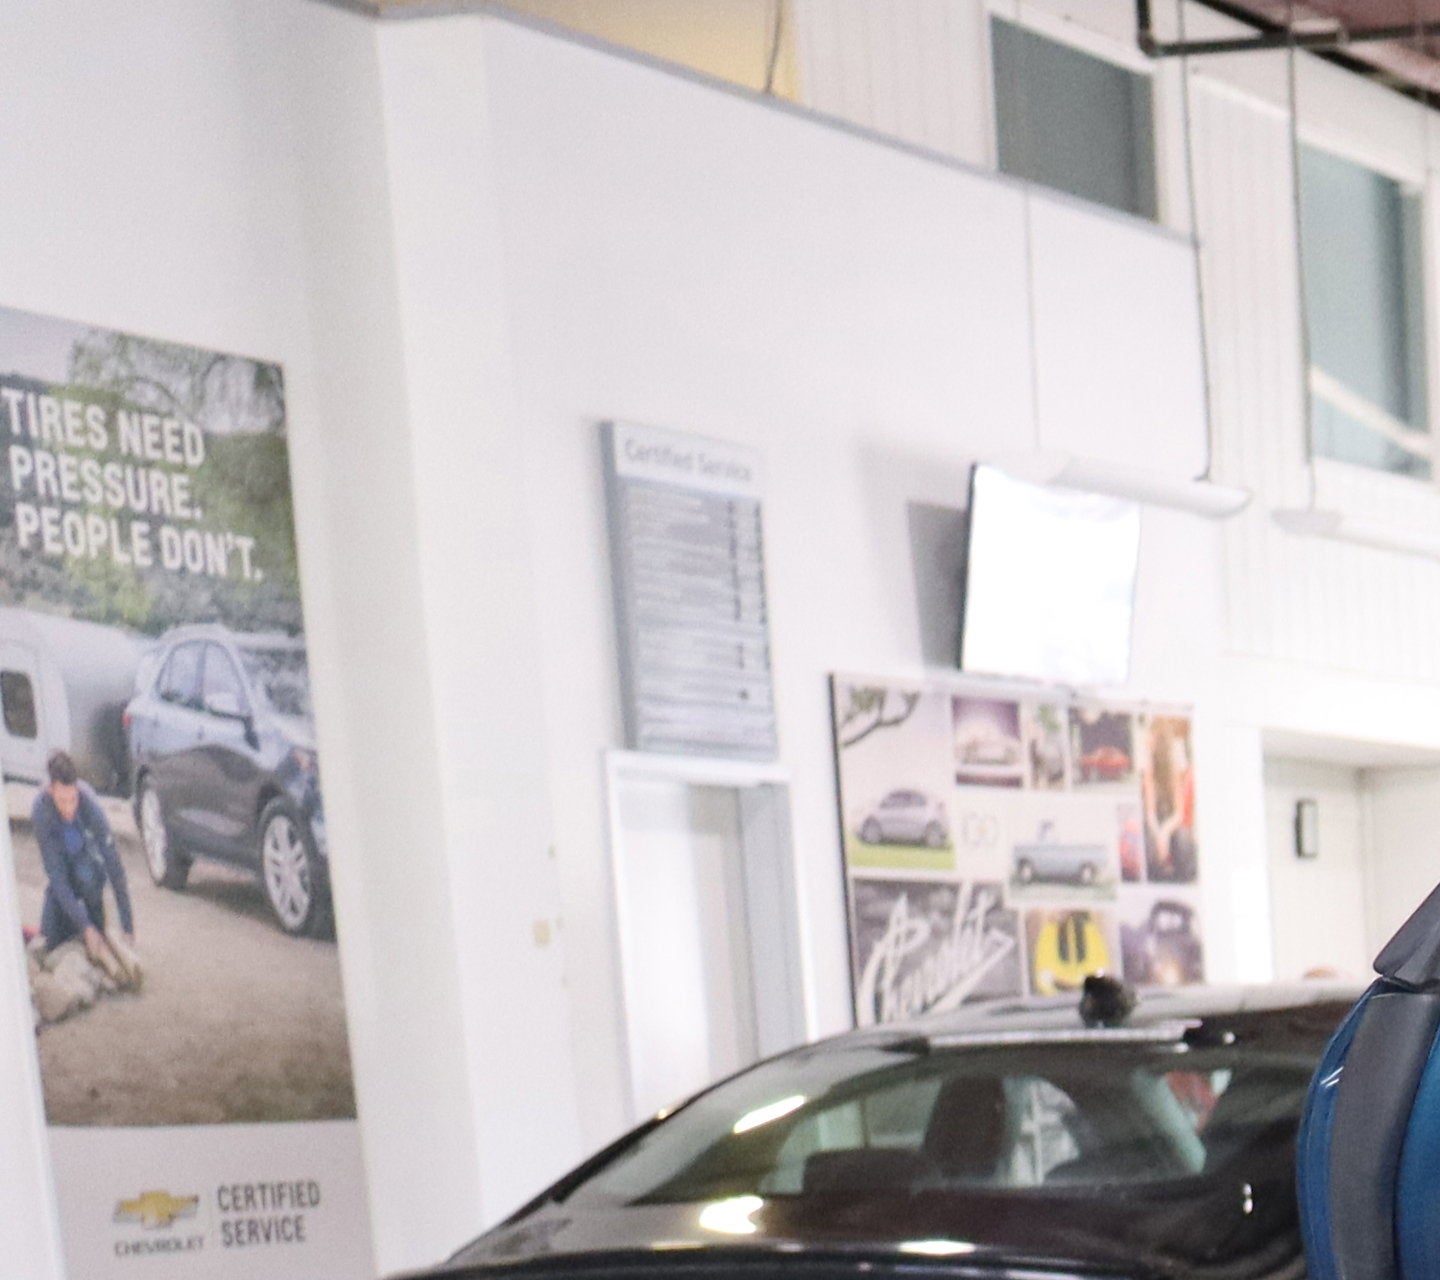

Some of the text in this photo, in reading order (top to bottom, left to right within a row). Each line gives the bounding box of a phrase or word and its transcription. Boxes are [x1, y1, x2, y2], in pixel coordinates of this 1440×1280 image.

[1, 387, 206, 467] TIRES NEED
[9, 445, 203, 520] PRESSURE.
[15, 503, 264, 581] PEOPLE DON'T.
[217, 1180, 320, 1212] CERTIFIED
[220, 1216, 305, 1248] SERVICE
